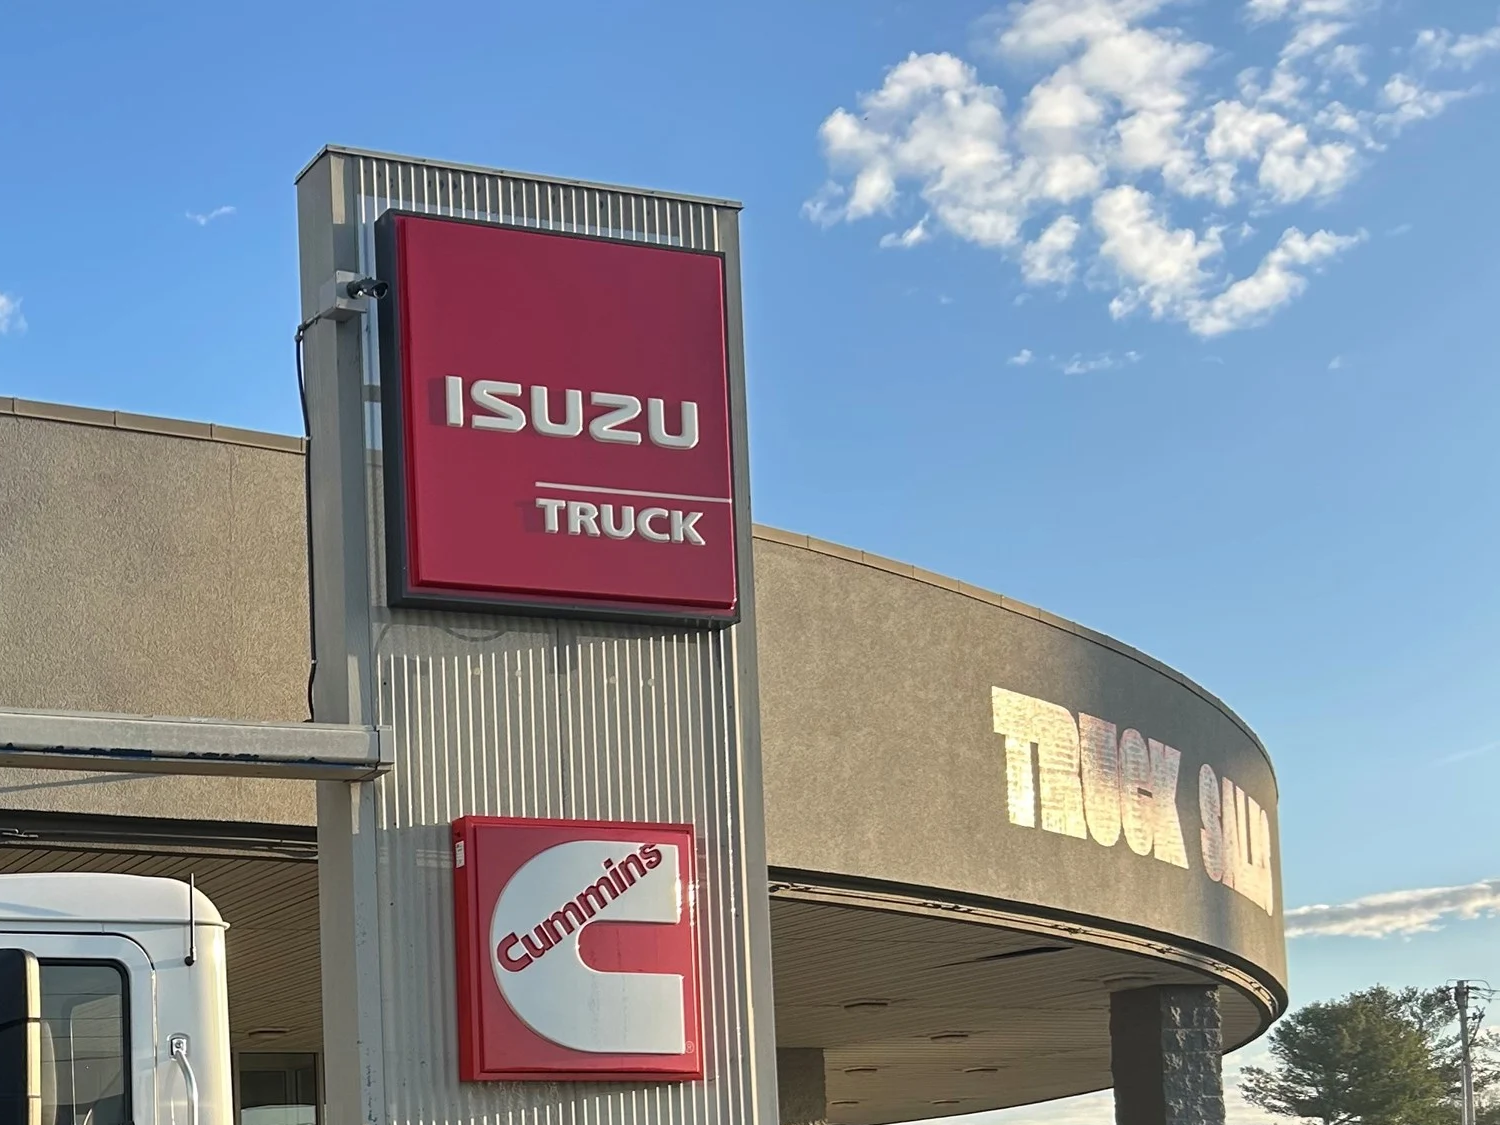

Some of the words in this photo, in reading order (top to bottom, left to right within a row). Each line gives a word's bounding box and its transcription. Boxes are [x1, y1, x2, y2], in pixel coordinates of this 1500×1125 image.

[444, 375, 700, 450] ISUZU
[535, 498, 706, 546] TRUCK
[991, 685, 1190, 870] TRUCK
[496, 843, 663, 973] Cummins
